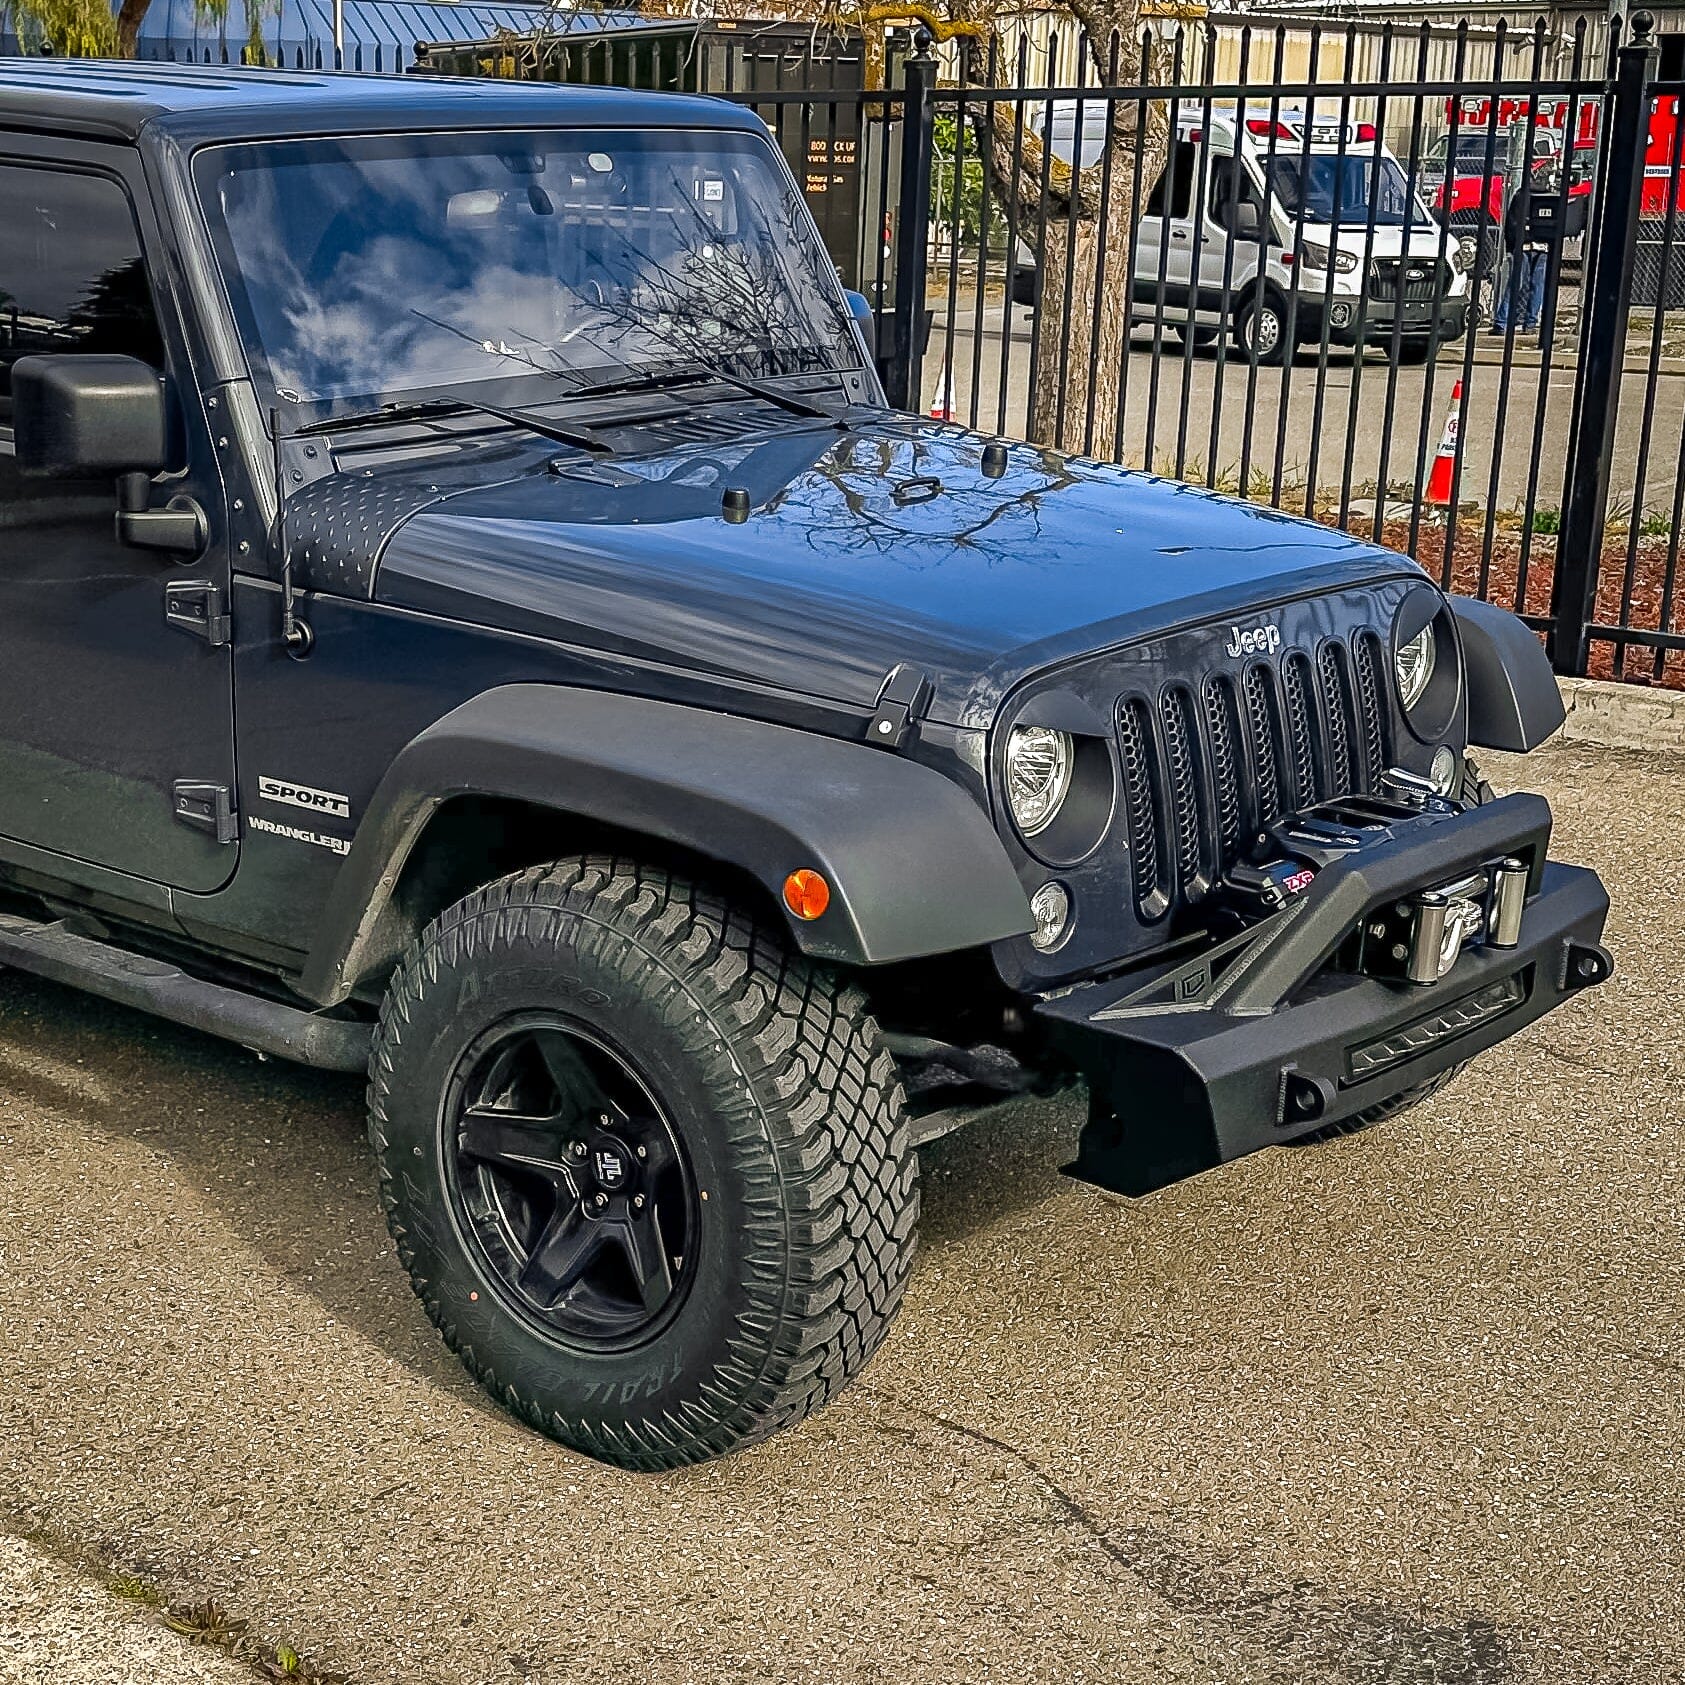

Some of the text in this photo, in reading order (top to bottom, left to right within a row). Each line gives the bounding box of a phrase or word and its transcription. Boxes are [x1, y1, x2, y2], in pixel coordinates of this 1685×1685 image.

[1226, 624, 1280, 657] Jeep
[262, 783, 347, 810] SPORT
[248, 816, 343, 850] WRANGLER
[582, 1343, 683, 1405] TRAIL
